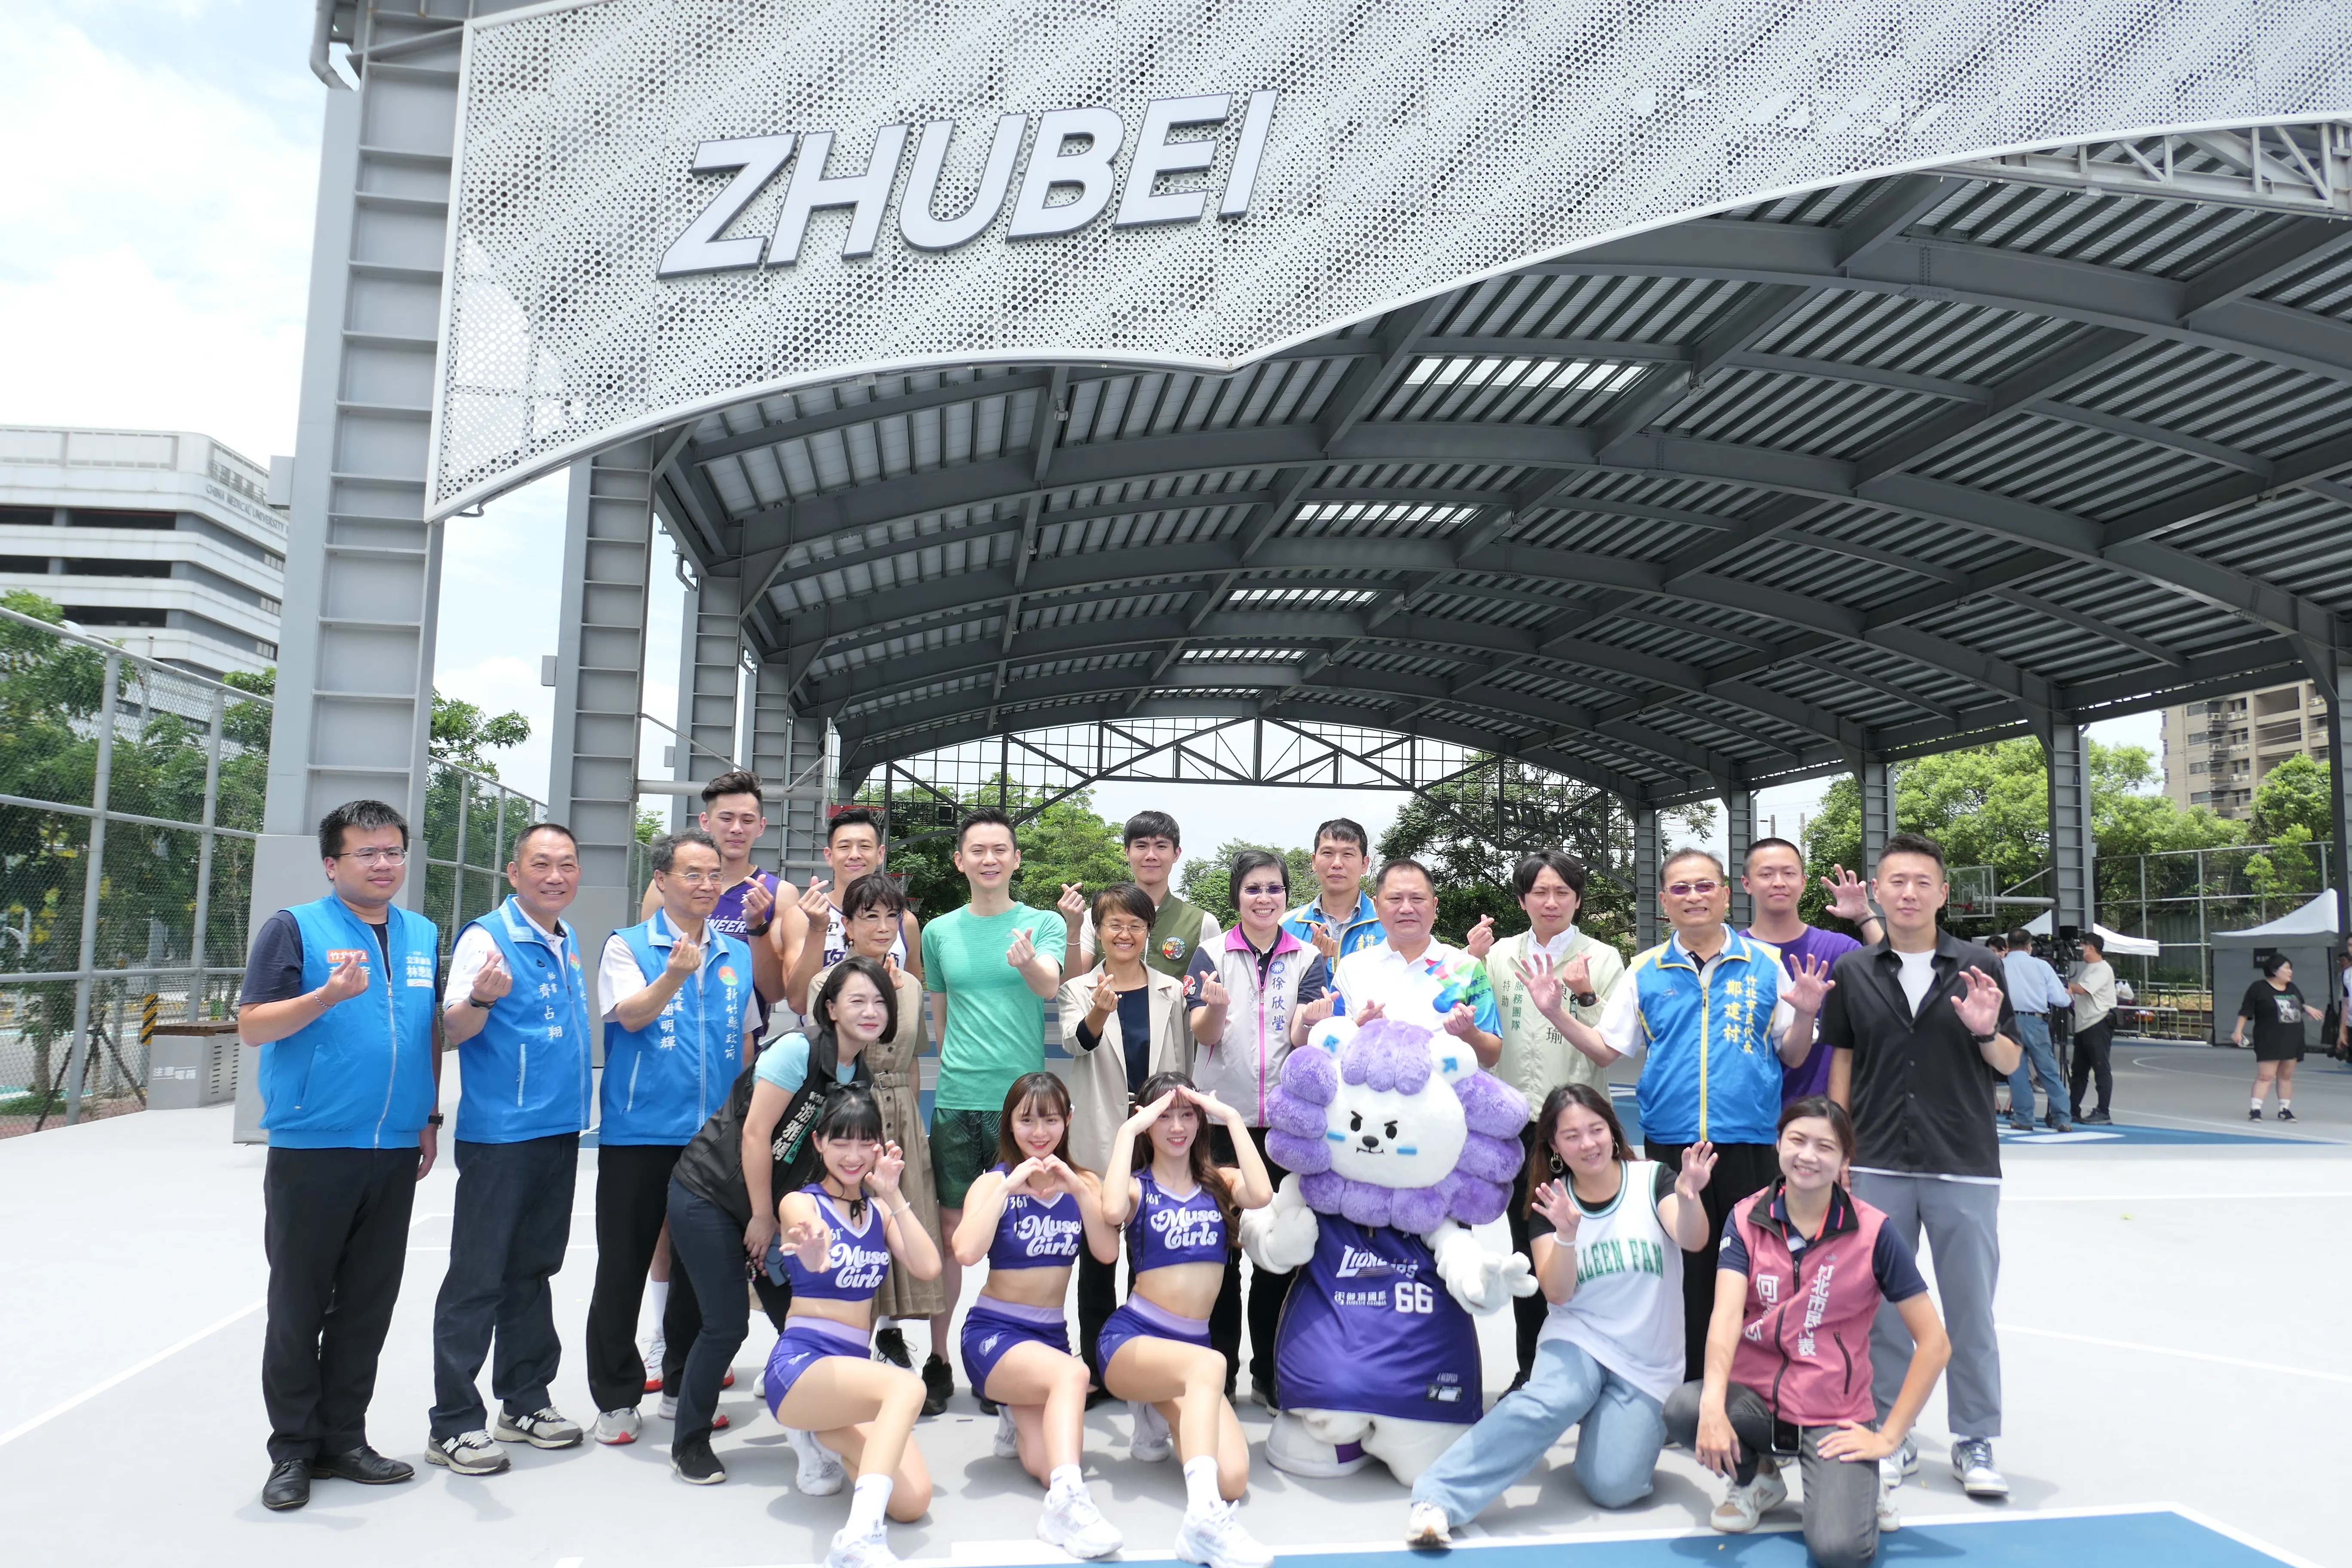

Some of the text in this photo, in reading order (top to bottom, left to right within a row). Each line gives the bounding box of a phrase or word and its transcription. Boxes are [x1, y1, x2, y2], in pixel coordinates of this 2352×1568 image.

[656, 87, 1280, 280] ZHUBEI
[206, 484, 285, 533] CHINA MEDICAL UNIVERSITY
[1271, 977, 1286, 1031] 徐欣瑩
[1501, 979, 1511, 1007] 特助
[1511, 981, 1524, 1031] 服務團隊
[1723, 979, 1743, 1043] 鄭建村
[725, 986, 738, 1060] 新竹縣政府
[1743, 974, 1758, 1054] 竹北市民代表
[1014, 1215, 1081, 1240] Muse
[1151, 1207, 1220, 1232] Muse
[1164, 1222, 1218, 1250] Girls
[830, 1243, 890, 1268] Muse
[1026, 1235, 1078, 1257] Girls
[1627, 1237, 1663, 1279] FAN
[835, 1265, 883, 1288] Girls
[1395, 1281, 1433, 1314] 66
